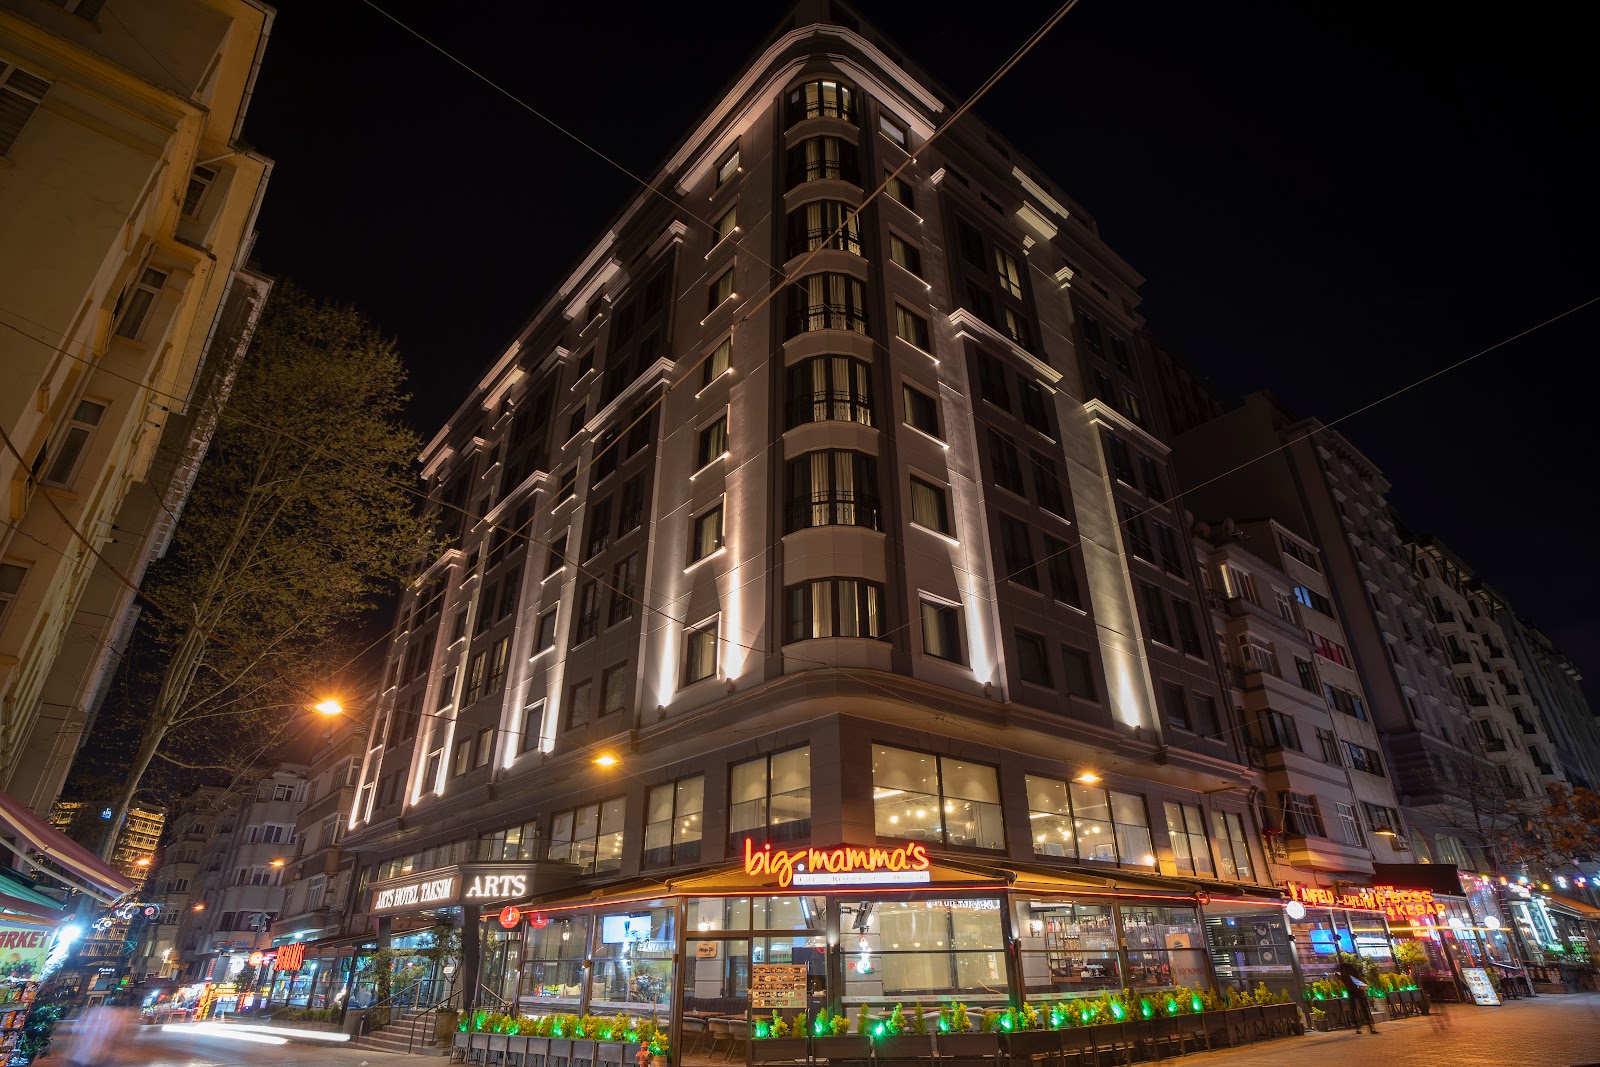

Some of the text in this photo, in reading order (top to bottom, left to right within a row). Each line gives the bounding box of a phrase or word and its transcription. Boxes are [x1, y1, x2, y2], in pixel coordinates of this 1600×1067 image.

[375, 878, 453, 910] ARTS HOTEL TAKSIM
[466, 874, 526, 897] ARTS
[1389, 890, 1434, 904] BOSS
[1396, 903, 1446, 916] KEBAP
